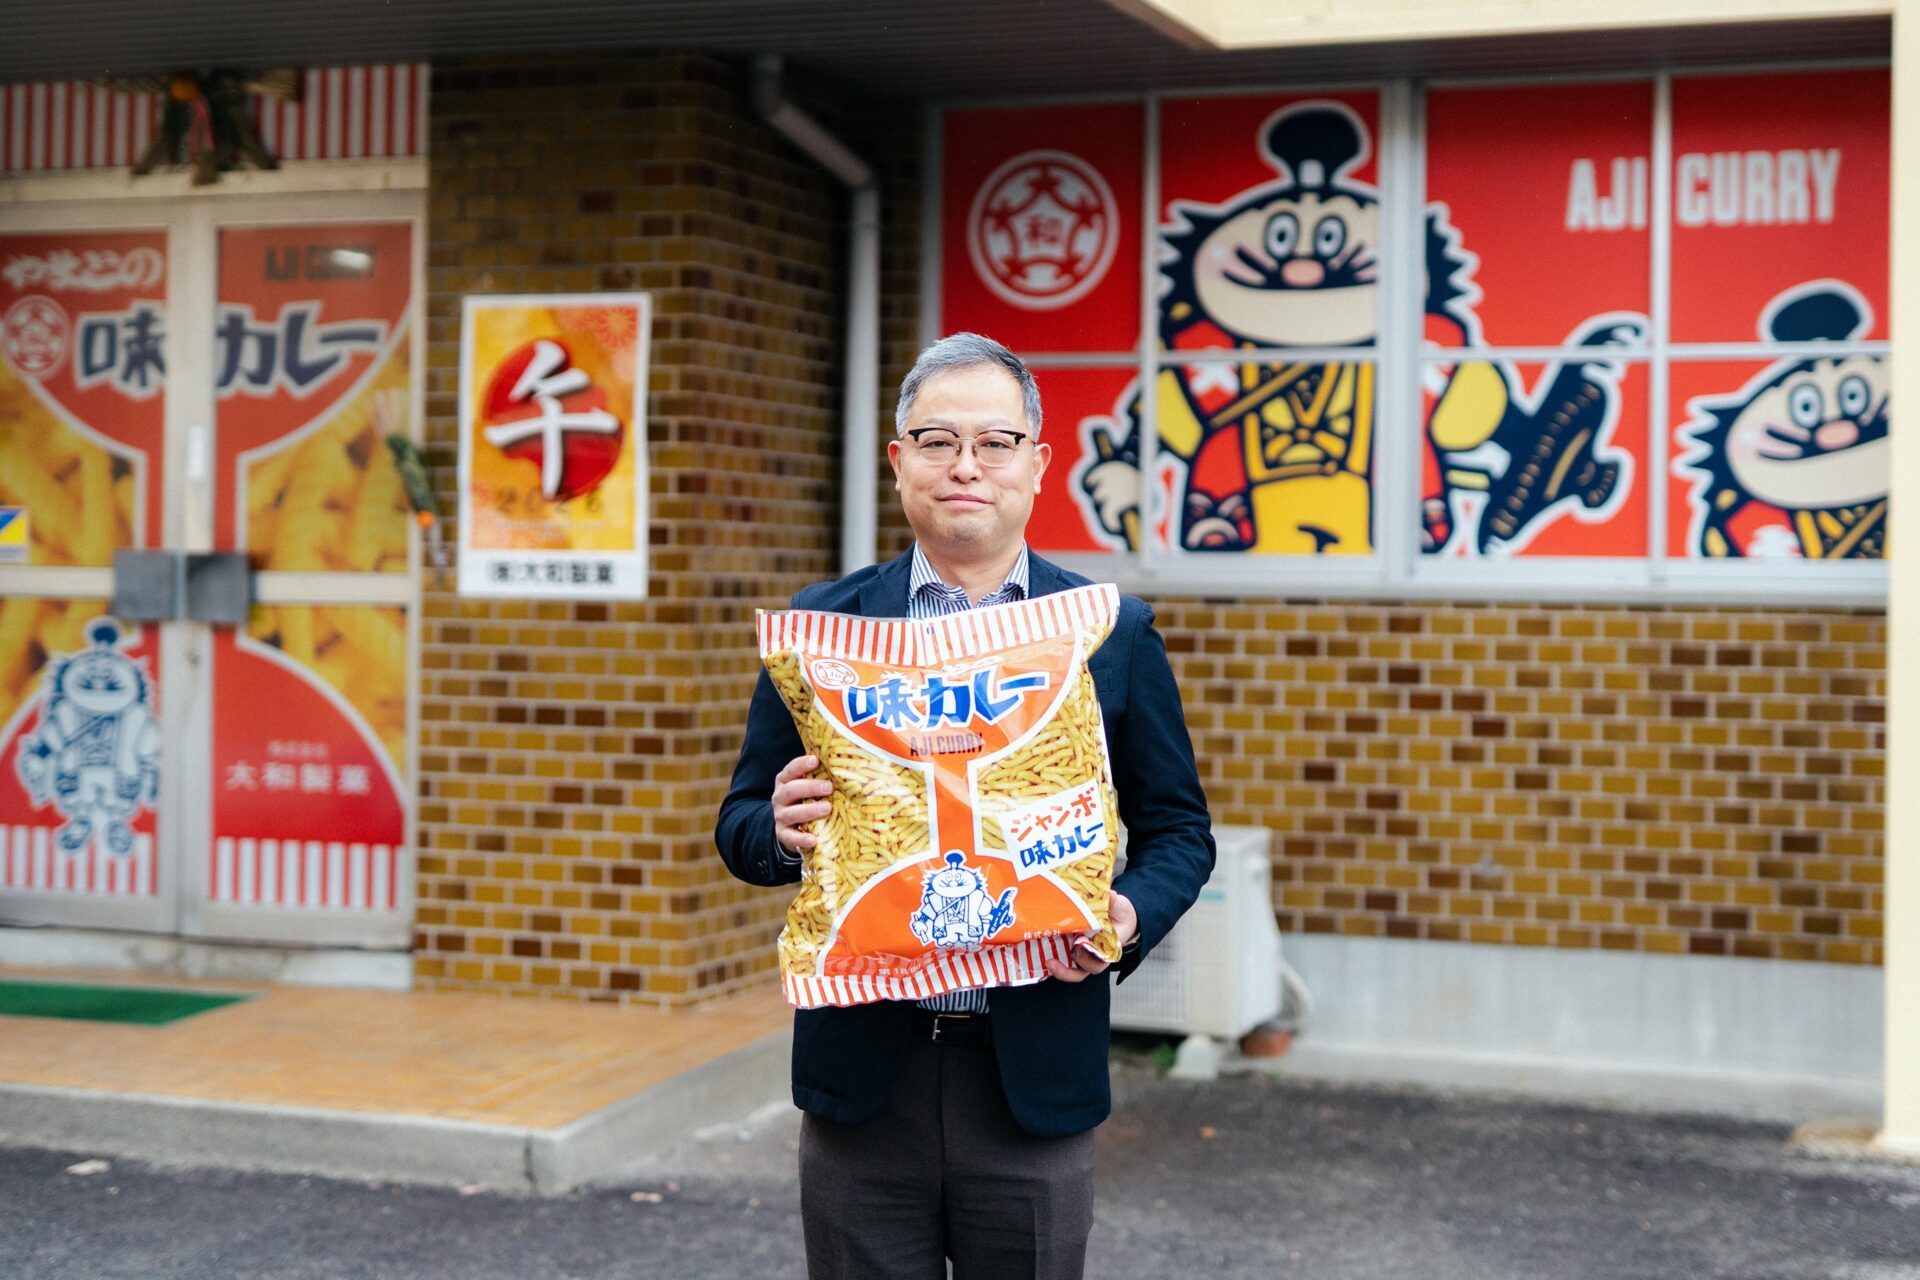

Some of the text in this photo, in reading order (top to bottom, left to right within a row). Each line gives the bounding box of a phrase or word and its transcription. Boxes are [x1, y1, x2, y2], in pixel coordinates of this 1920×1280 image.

[1565, 148, 1841, 231] AJI CURRY
[483, 340, 619, 498] 午
[847, 670, 1046, 729] 味カレー
[910, 731, 984, 757] AJI CURRY
[1010, 786, 1097, 842] ジャンボ
[1019, 822, 1104, 869] 味カレー
